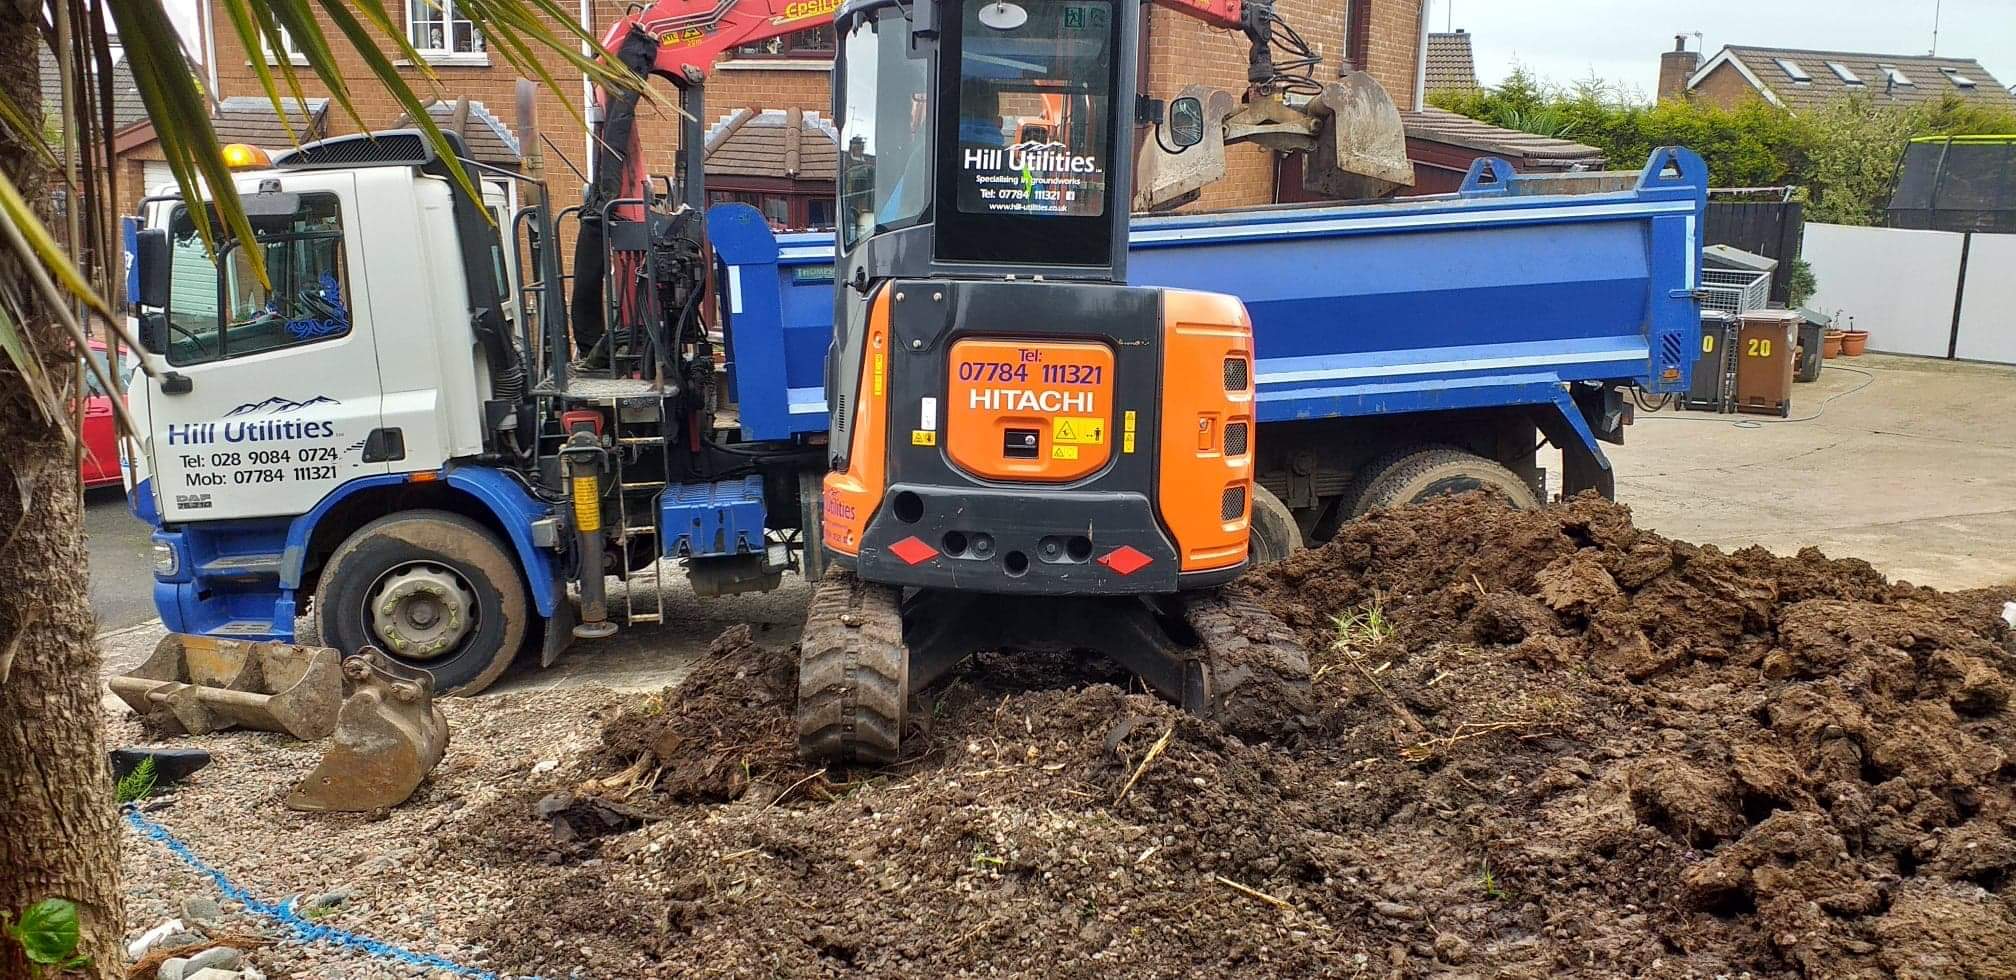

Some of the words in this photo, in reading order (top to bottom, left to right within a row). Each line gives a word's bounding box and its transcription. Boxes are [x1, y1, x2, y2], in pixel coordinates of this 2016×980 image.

[964, 149, 1001, 170] Hill
[1009, 150, 1095, 173] Utilities
[1031, 176, 1080, 186] groundworks
[980, 189, 996, 199] Tel:
[999, 189, 1029, 200] 07784
[1034, 190, 1060, 201] 111321
[1018, 348, 1042, 363] Tel:
[1748, 338, 1771, 357] 20
[959, 361, 1028, 383] 07784
[1042, 364, 1101, 385] 111321
[969, 388, 1094, 413] HITACHI
[169, 423, 214, 445] Hill
[224, 418, 334, 443] Utilities
[180, 453, 205, 468] Tel:
[211, 453, 241, 467] 028
[248, 450, 290, 465] 9084
[298, 447, 338, 462] 0724
[186, 473, 226, 487] Mob:
[234, 469, 285, 484] 07784
[293, 465, 337, 481] 111321
